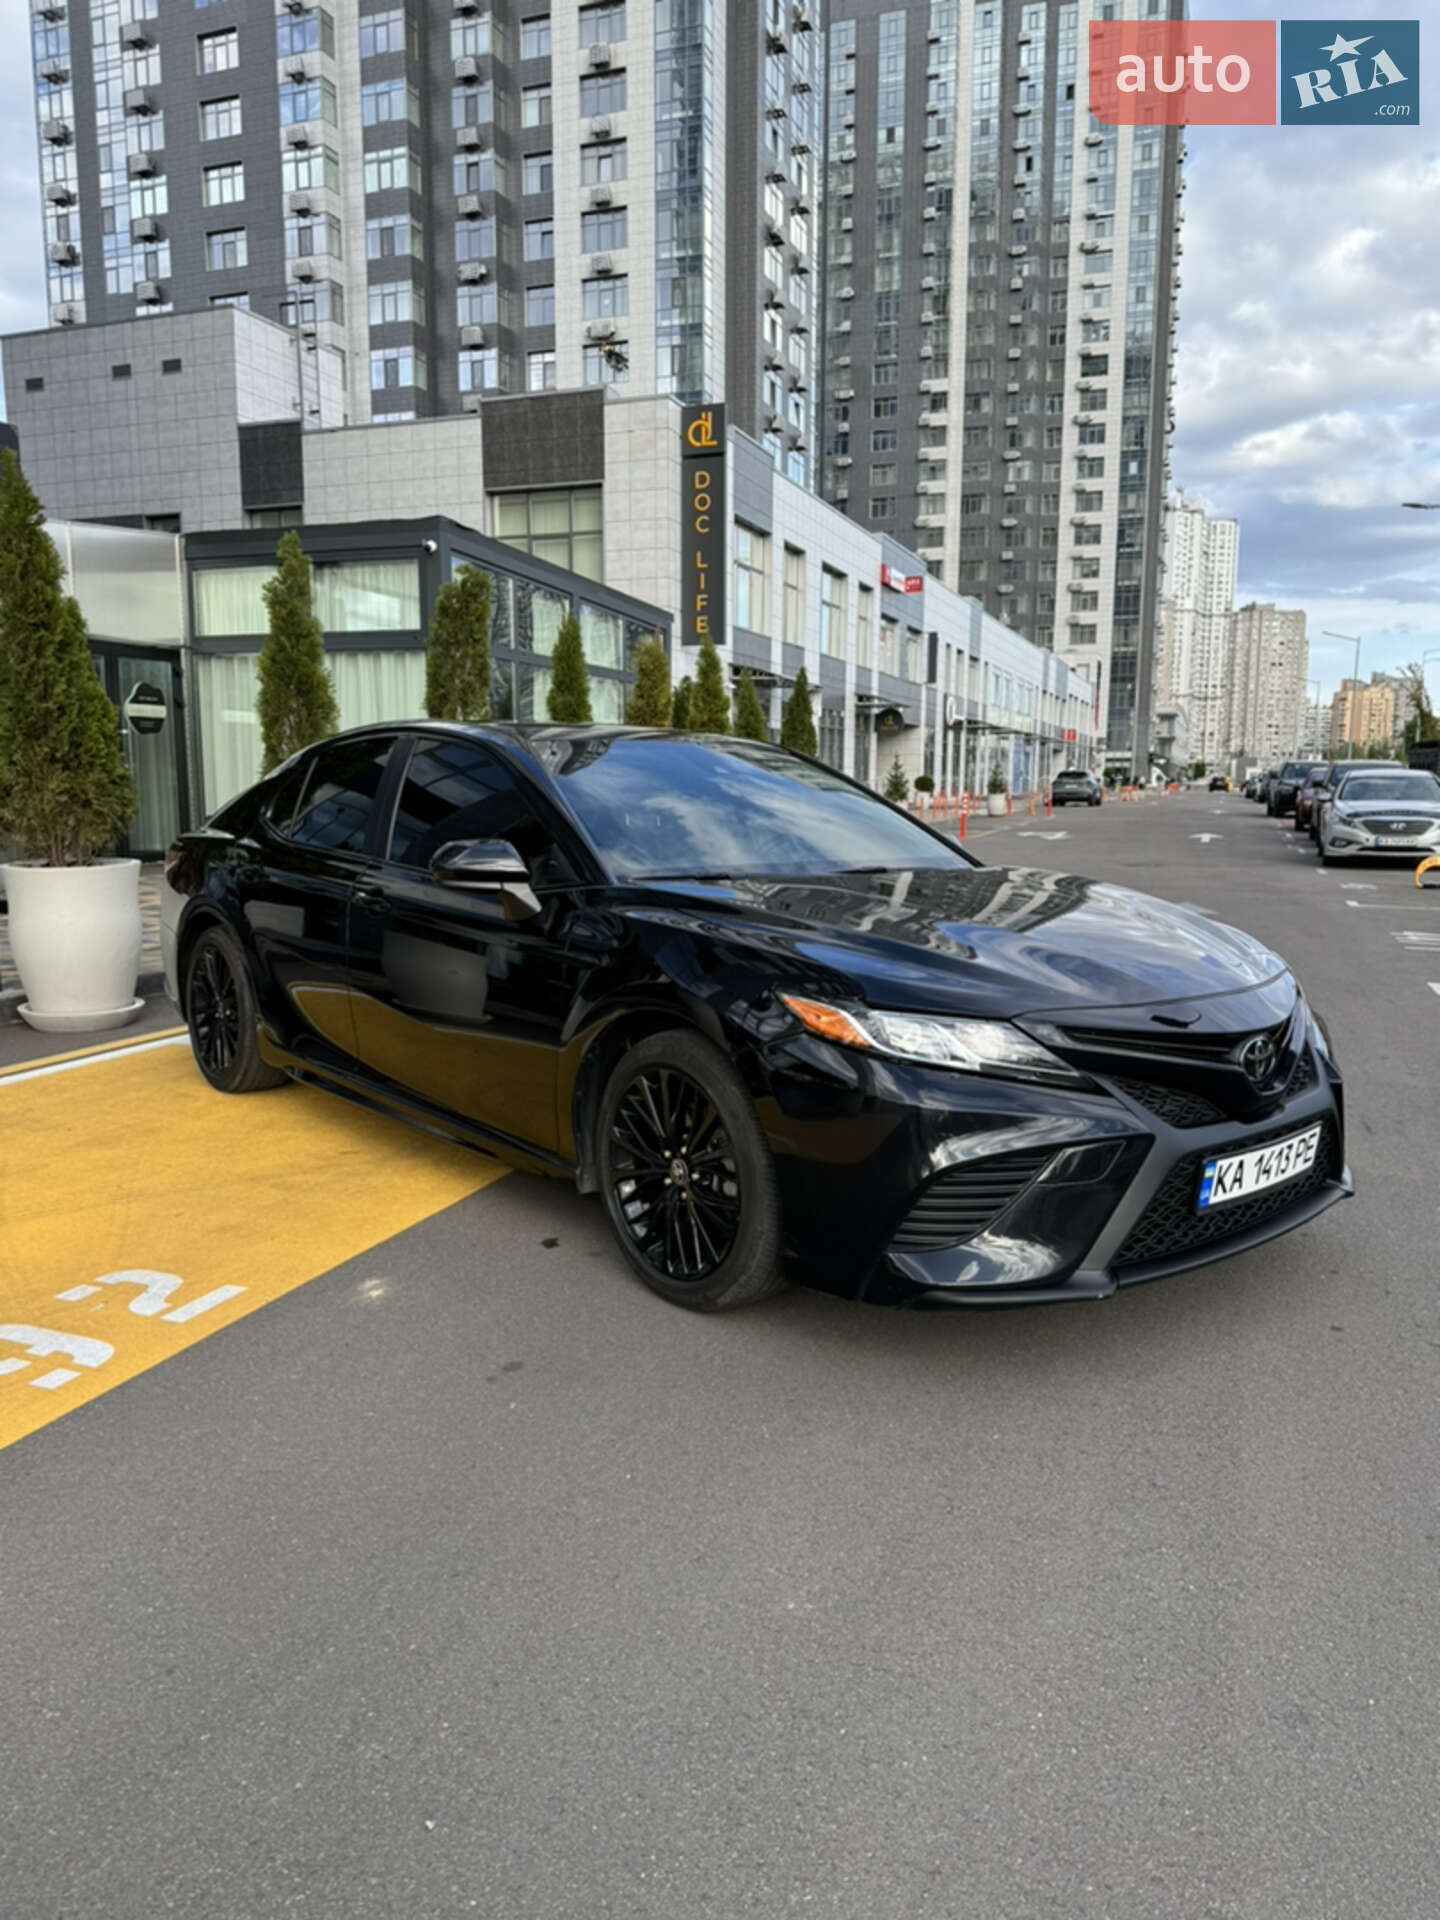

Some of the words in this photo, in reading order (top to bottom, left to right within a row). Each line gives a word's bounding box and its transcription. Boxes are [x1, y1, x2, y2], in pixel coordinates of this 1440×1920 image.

[693, 470, 712, 533] DOC
[695, 550, 709, 634] LIFE
[1213, 1159, 1245, 1197] KA
[1253, 1144, 1294, 1185] 1413
[1292, 1131, 1318, 1169] PE
